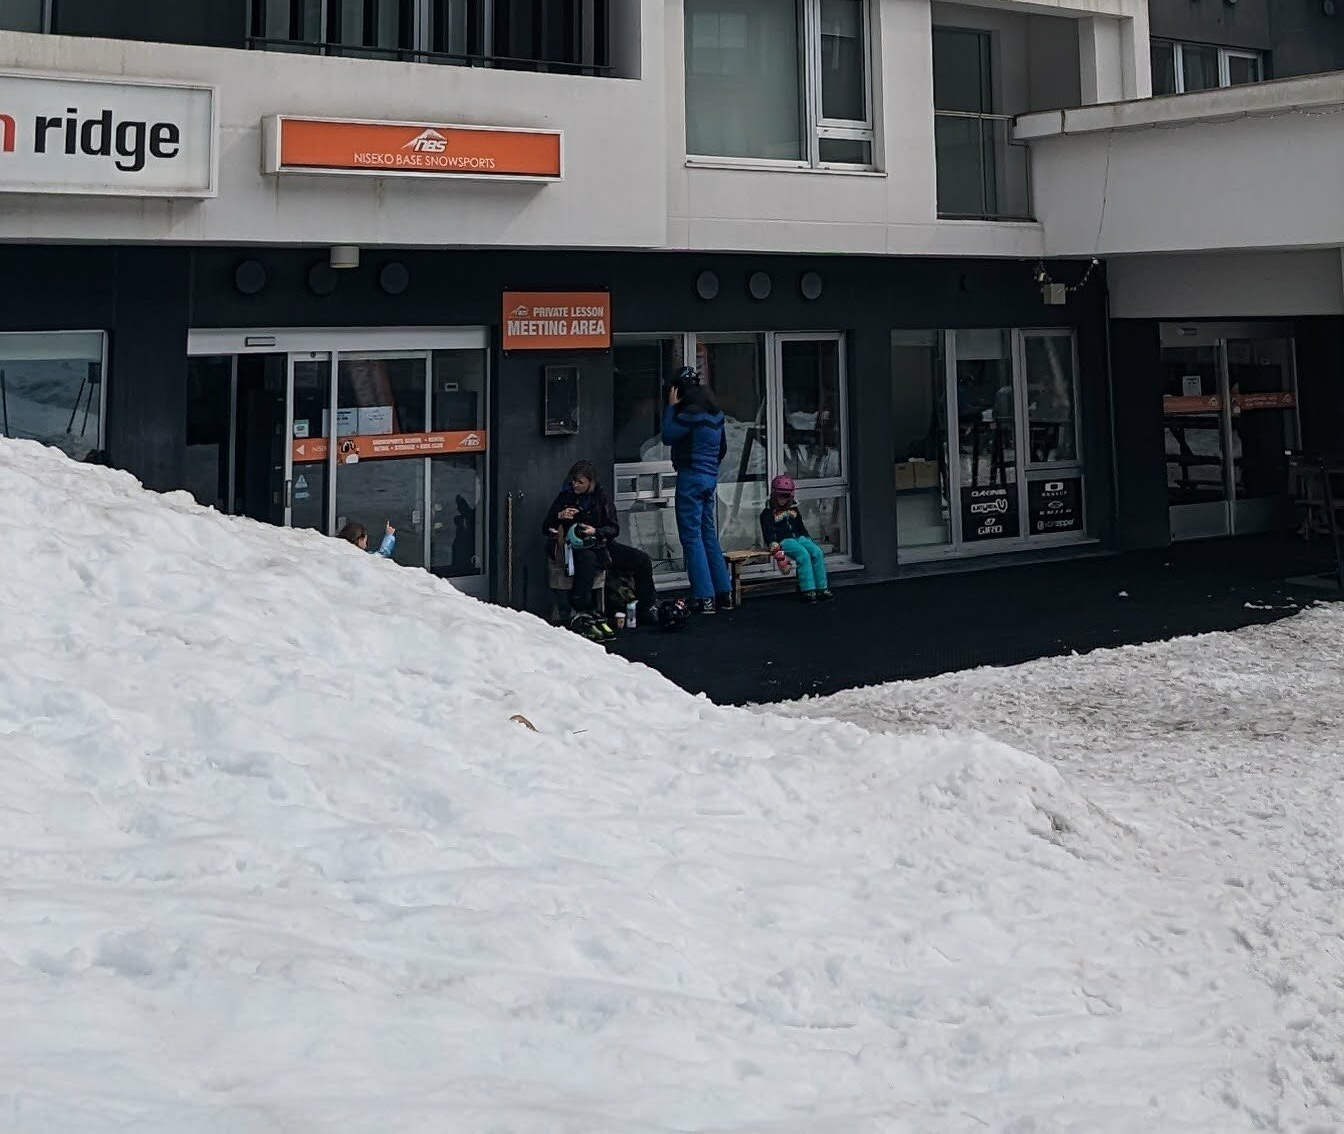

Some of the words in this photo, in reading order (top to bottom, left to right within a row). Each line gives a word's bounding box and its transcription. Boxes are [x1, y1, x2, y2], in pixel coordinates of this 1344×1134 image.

[34, 107, 180, 172] ridge
[354, 153, 394, 165] NISEKO
[396, 154, 422, 166] BASE
[425, 155, 495, 169] SNOWSPORTS
[533, 306, 569, 318] PRIVATE
[571, 306, 605, 318] LESSON
[507, 320, 568, 337] MEETING
[570, 319, 606, 336] AREA
